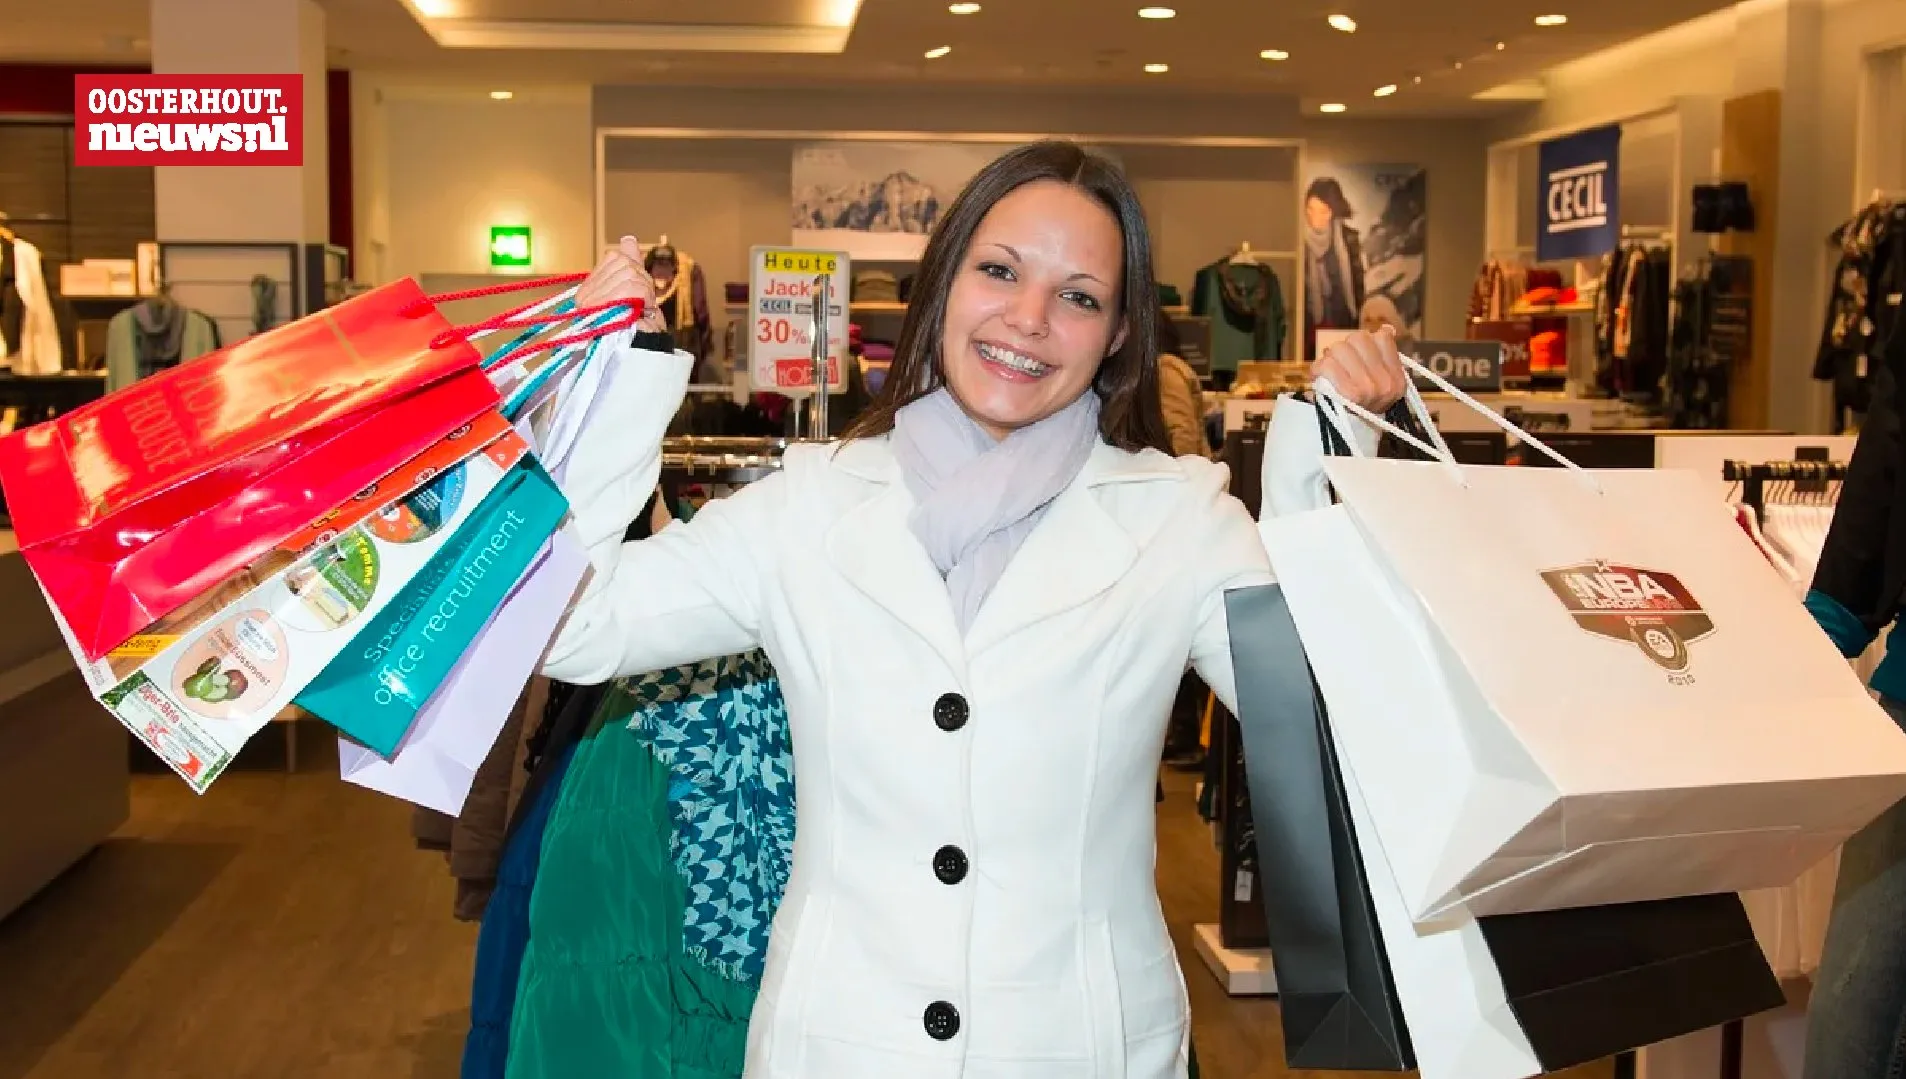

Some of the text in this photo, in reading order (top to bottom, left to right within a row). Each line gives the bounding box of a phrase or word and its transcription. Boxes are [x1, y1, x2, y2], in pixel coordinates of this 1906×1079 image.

[1548, 172, 1607, 221] CECIL
[764, 253, 837, 271] Heute
[1428, 351, 1491, 378] One
[122, 391, 190, 474] HOUSE
[420, 509, 526, 642] recruitment
[1576, 573, 1676, 600] NBA
